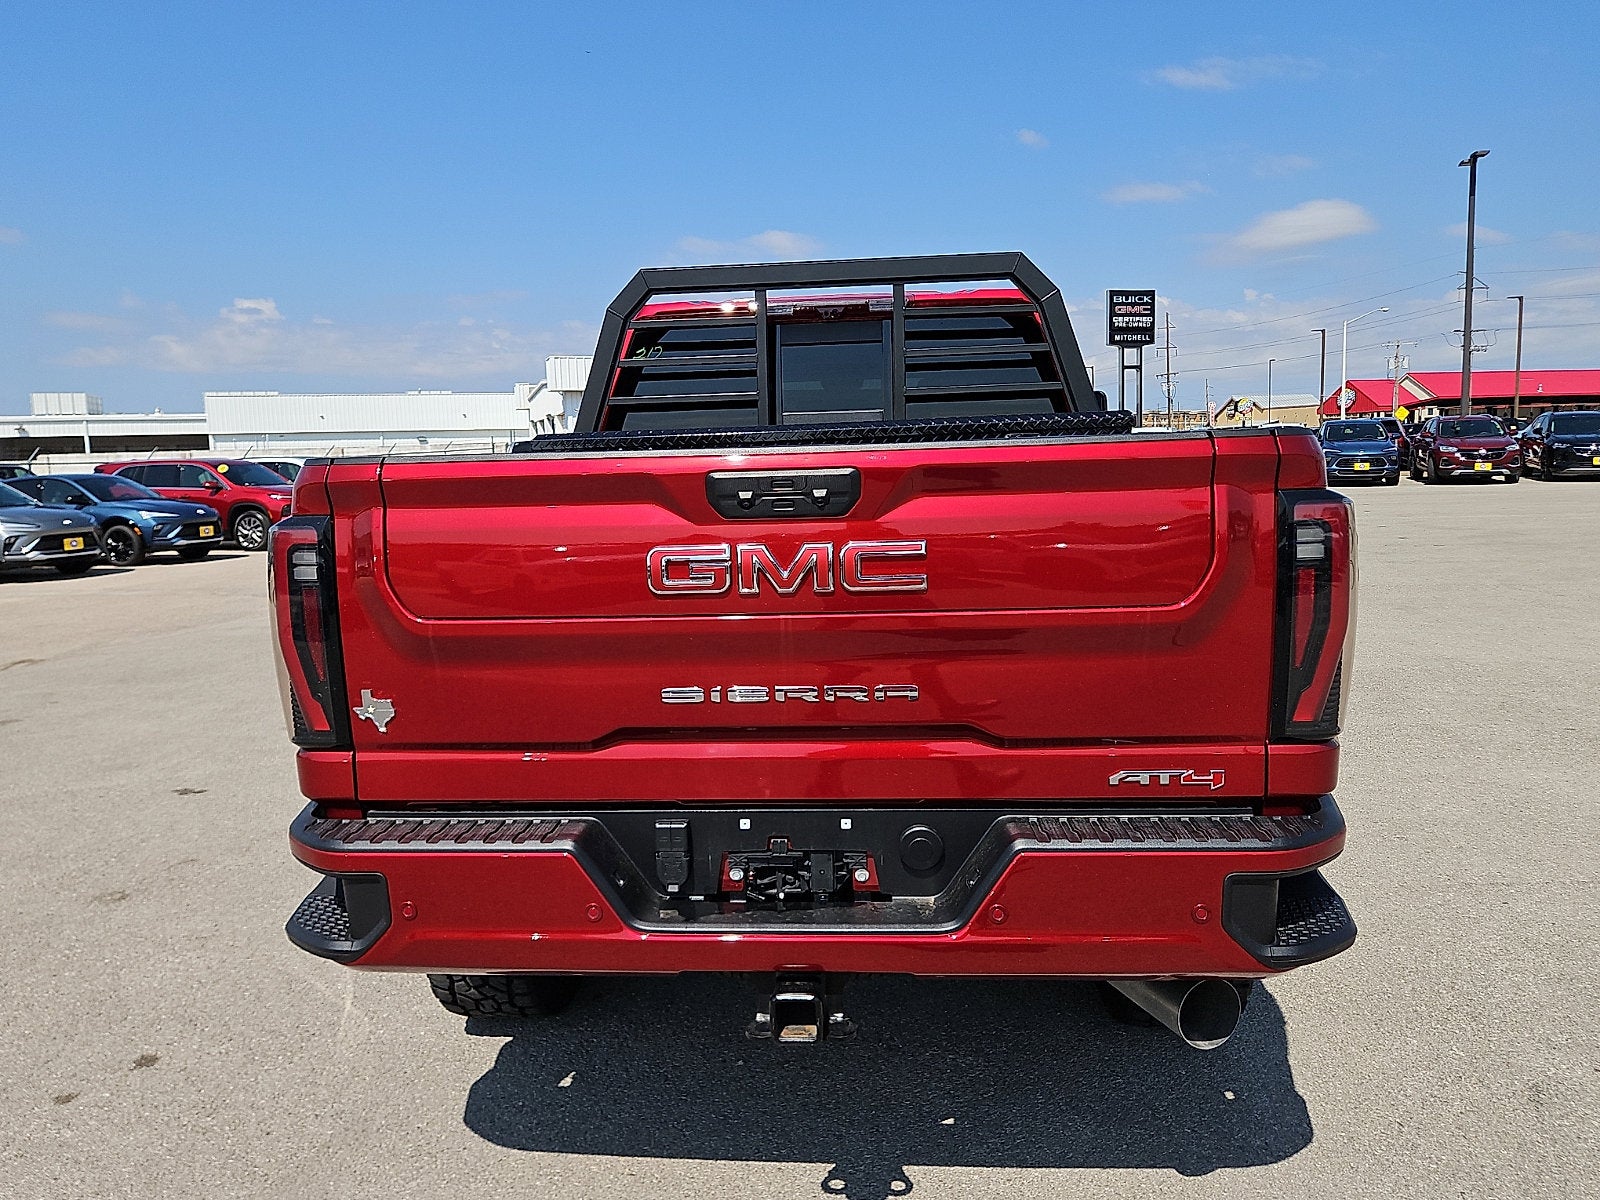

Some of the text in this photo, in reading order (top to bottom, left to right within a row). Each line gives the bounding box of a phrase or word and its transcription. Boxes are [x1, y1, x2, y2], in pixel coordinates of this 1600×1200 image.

[1113, 295, 1152, 303] BUICK
[1114, 305, 1151, 314] GMC
[646, 539, 928, 595] GMC
[661, 684, 919, 703] SIERRA
[1109, 769, 1225, 790] AT4
